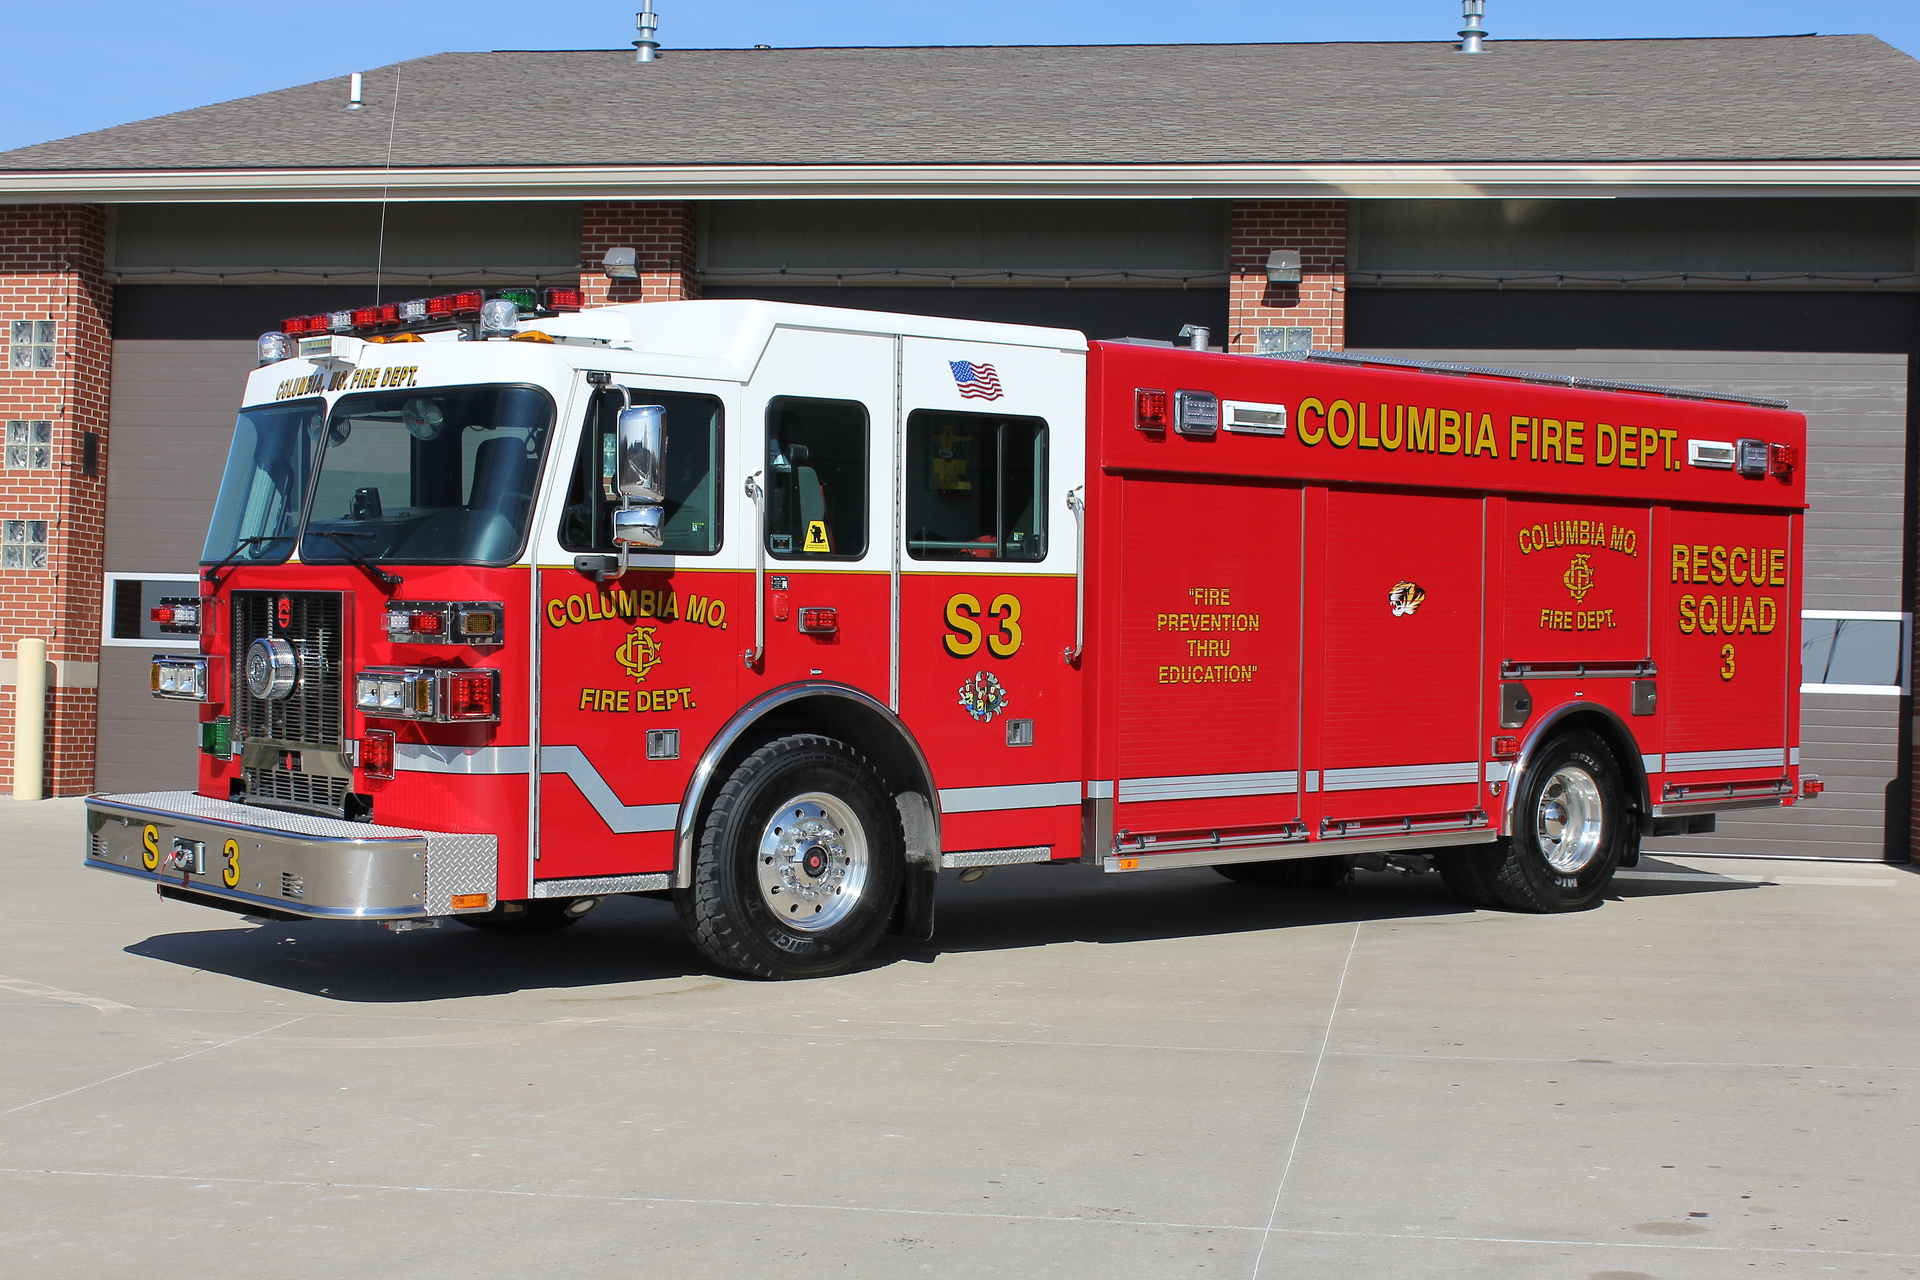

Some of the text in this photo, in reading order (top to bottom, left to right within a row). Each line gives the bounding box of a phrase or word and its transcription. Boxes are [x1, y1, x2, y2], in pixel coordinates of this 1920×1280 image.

[276, 374, 324, 400] COLUMBIA,
[350, 367, 381, 389] FIRE
[380, 366, 418, 387] DEPT.
[1296, 397, 1681, 471] COLUMBIA FIRE DEPT.
[1519, 520, 1638, 558] COLUMBIA MO.
[1671, 544, 1785, 587] RESCUE
[546, 589, 728, 631] COLUMBIA MO.
[1188, 588, 1231, 606] "FIRE
[1679, 594, 1777, 636] SQUAD
[944, 594, 1023, 660] S3
[1157, 613, 1260, 632] PREVENTION
[1540, 609, 1617, 631] FIRE DEPT.
[1187, 639, 1230, 657] THRU
[1720, 643, 1736, 680] 3
[1159, 664, 1258, 684] EDUCATION"
[579, 687, 697, 712] FIRE DEPT.
[142, 823, 241, 889] S 3
